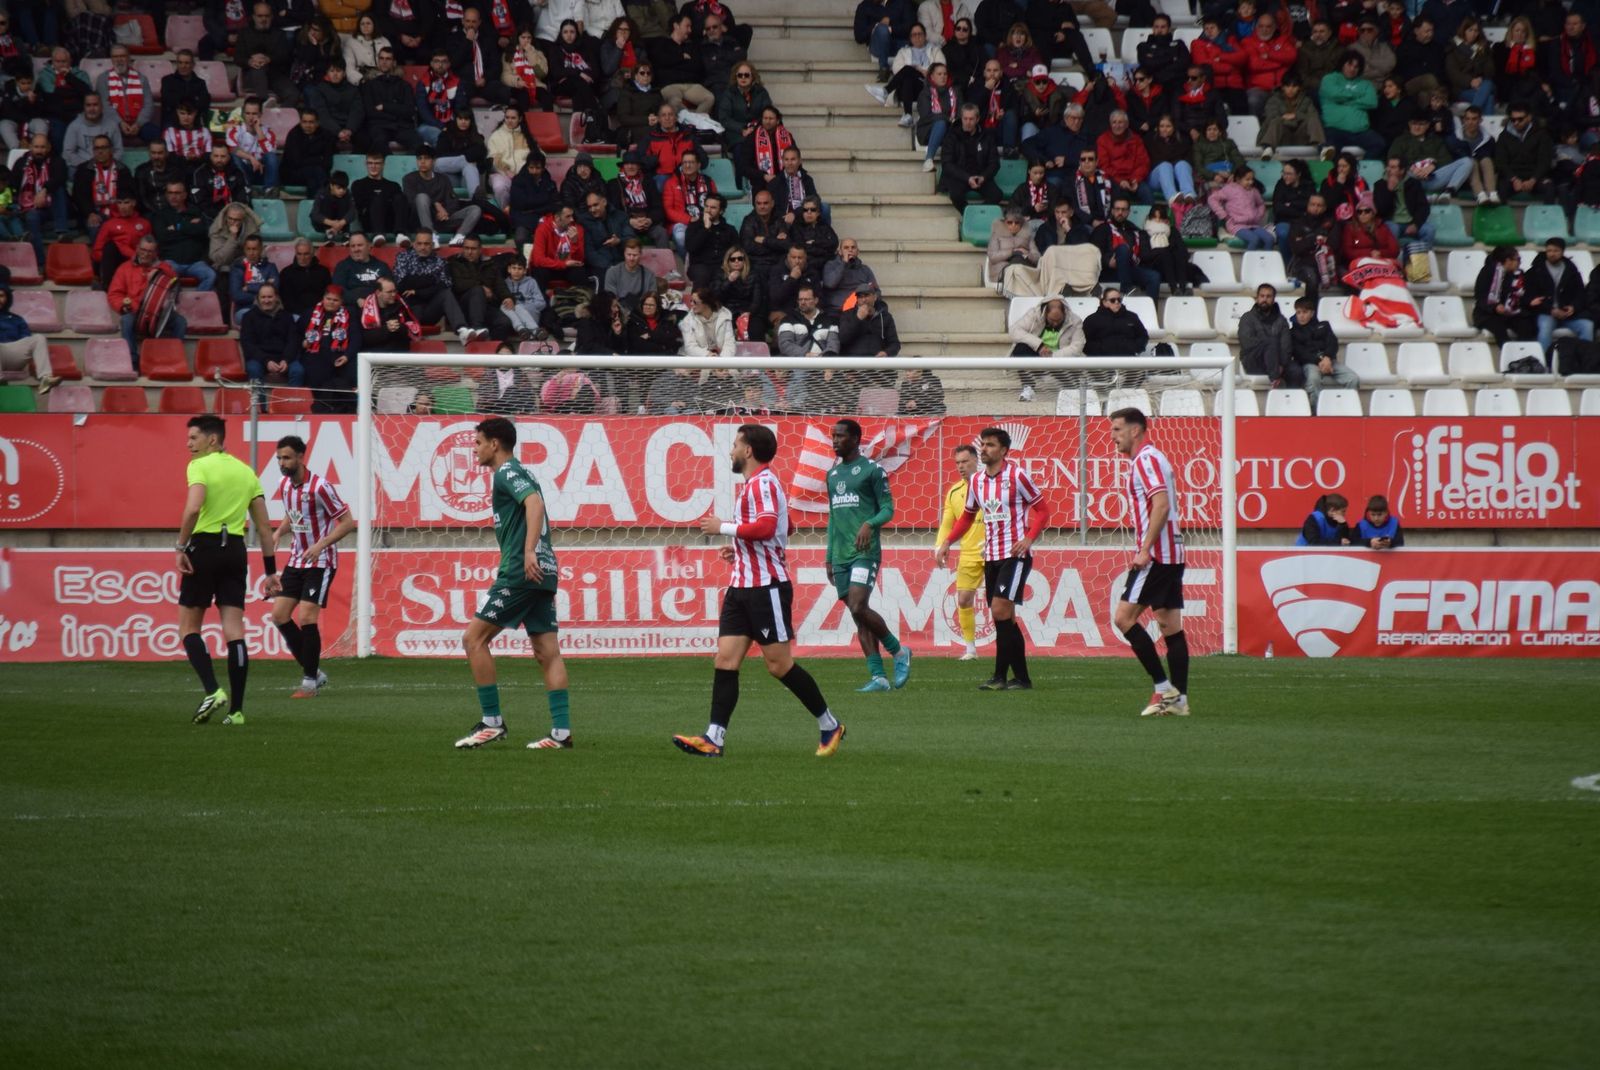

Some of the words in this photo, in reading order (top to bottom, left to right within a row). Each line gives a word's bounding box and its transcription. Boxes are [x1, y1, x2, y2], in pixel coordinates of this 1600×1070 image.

[1006, 457, 1131, 489] ENTR
[1425, 425, 1560, 488] fisio
[1072, 491, 1268, 522] RORO
[1426, 472, 1581, 519] readapt
[1427, 509, 1535, 520] POLICLÍNICA
[60, 613, 294, 658] infanti
